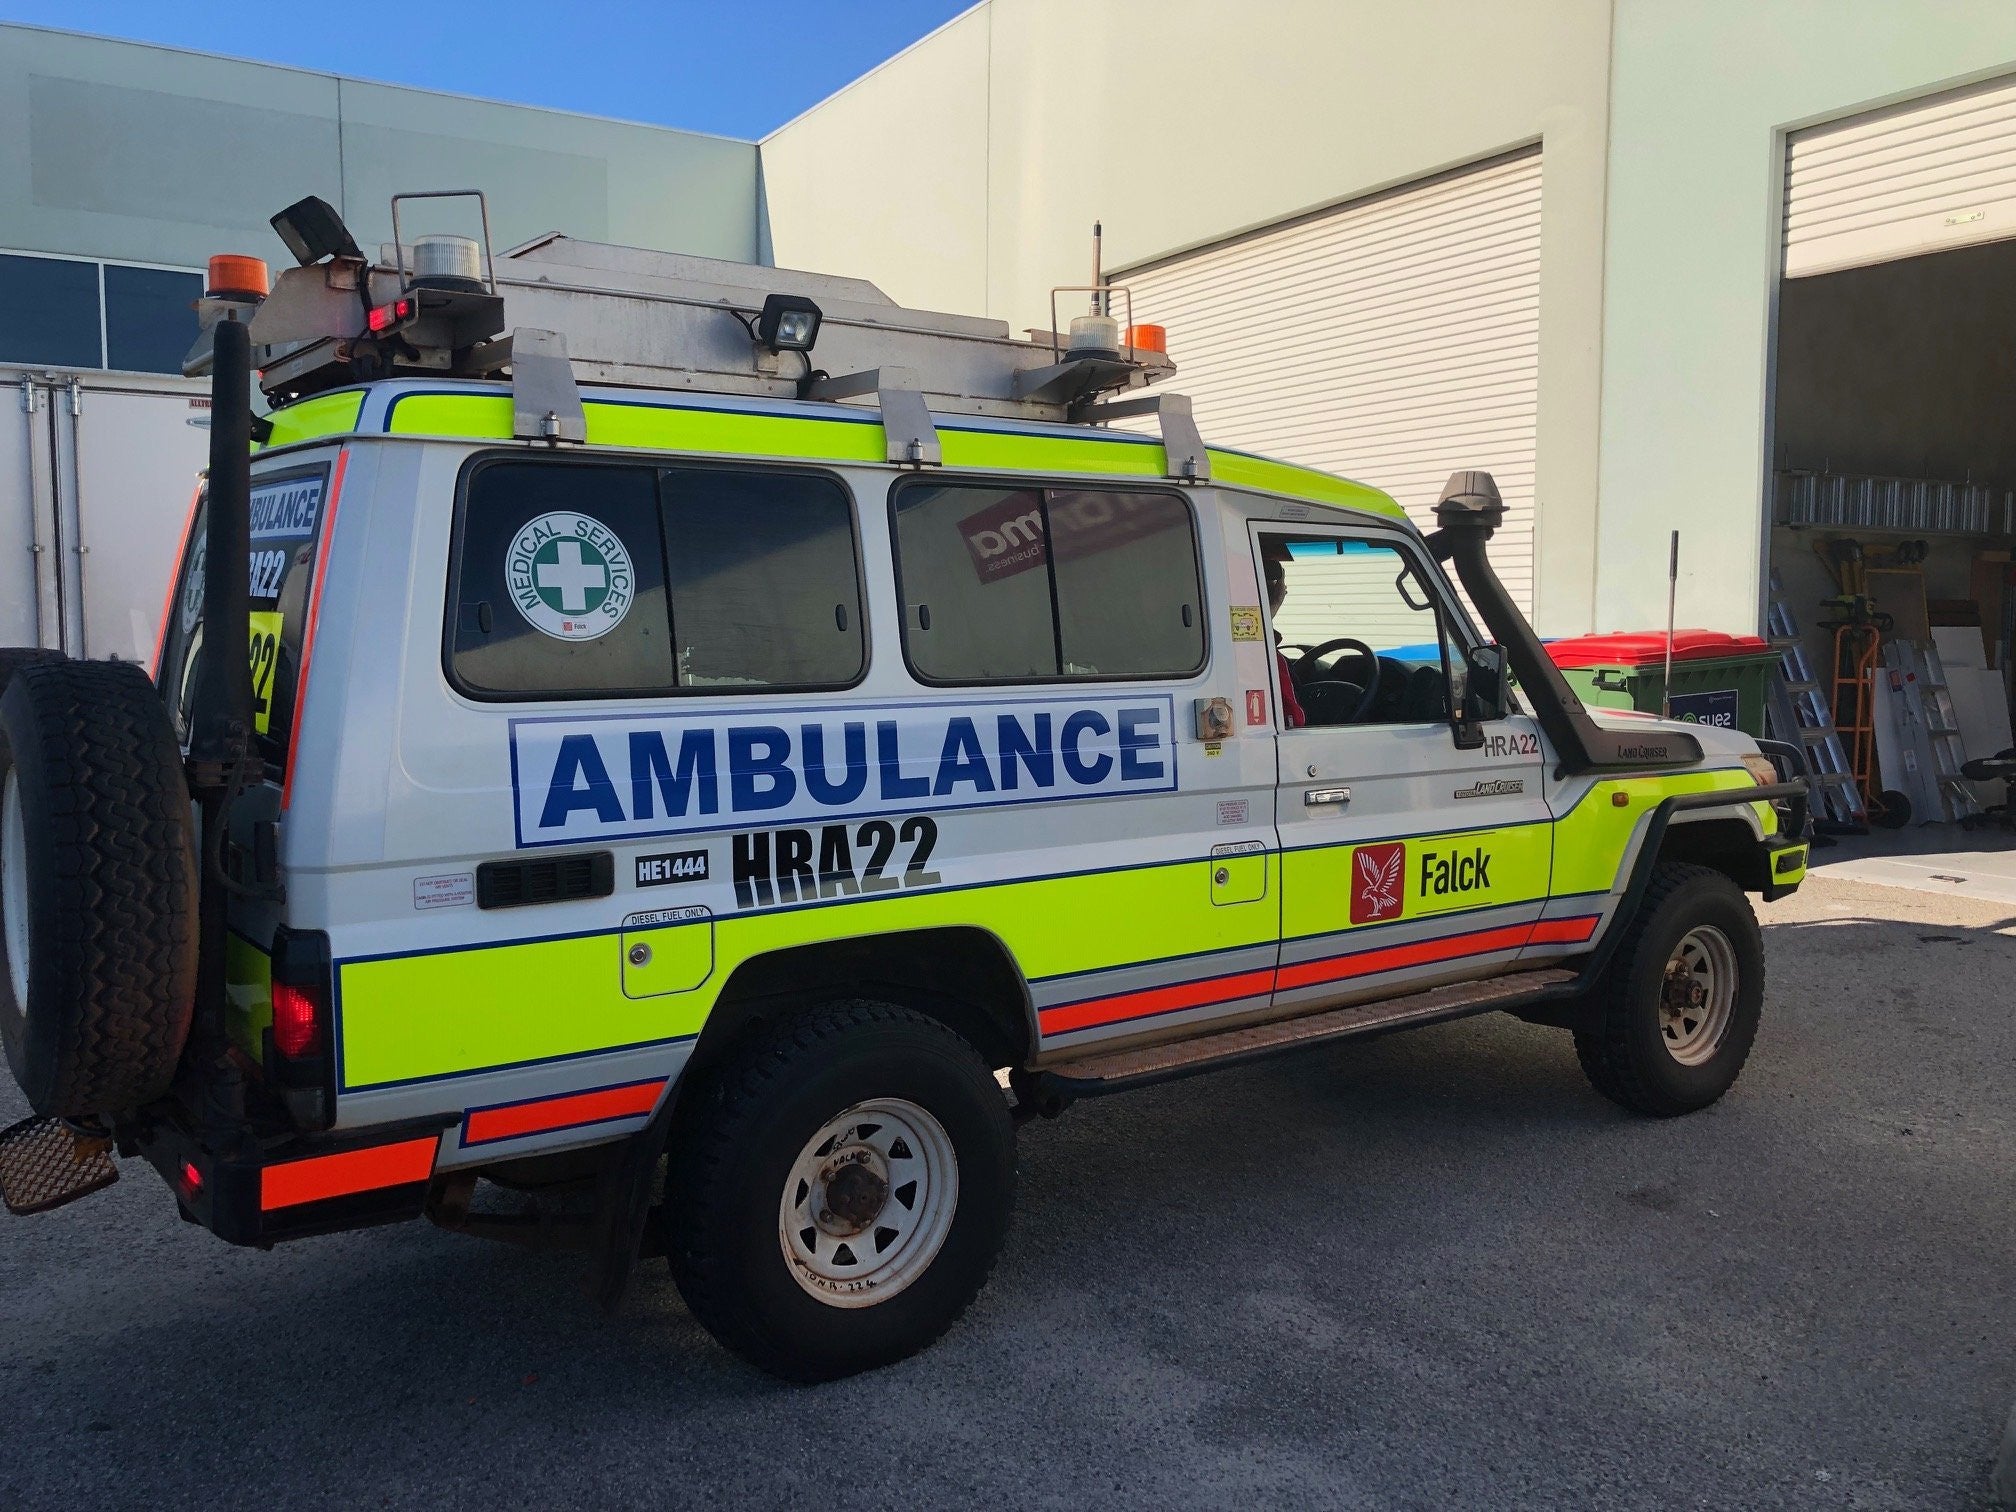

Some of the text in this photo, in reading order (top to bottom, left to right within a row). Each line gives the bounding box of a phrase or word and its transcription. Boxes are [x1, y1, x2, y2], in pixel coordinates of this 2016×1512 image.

[250, 489, 319, 531] BULANCE
[250, 550, 286, 598] A22
[513, 520, 629, 619] MEDICAL SERVICES
[538, 707, 1165, 828] AMBULANCE
[1484, 734, 1538, 757] HRA22
[638, 855, 706, 882] HE1444
[732, 816, 941, 909] HRA22
[1216, 847, 1233, 855] DIESEL
[1420, 847, 1491, 898] Falck
[631, 908, 704, 925] DIESEL FUEL ONLY
